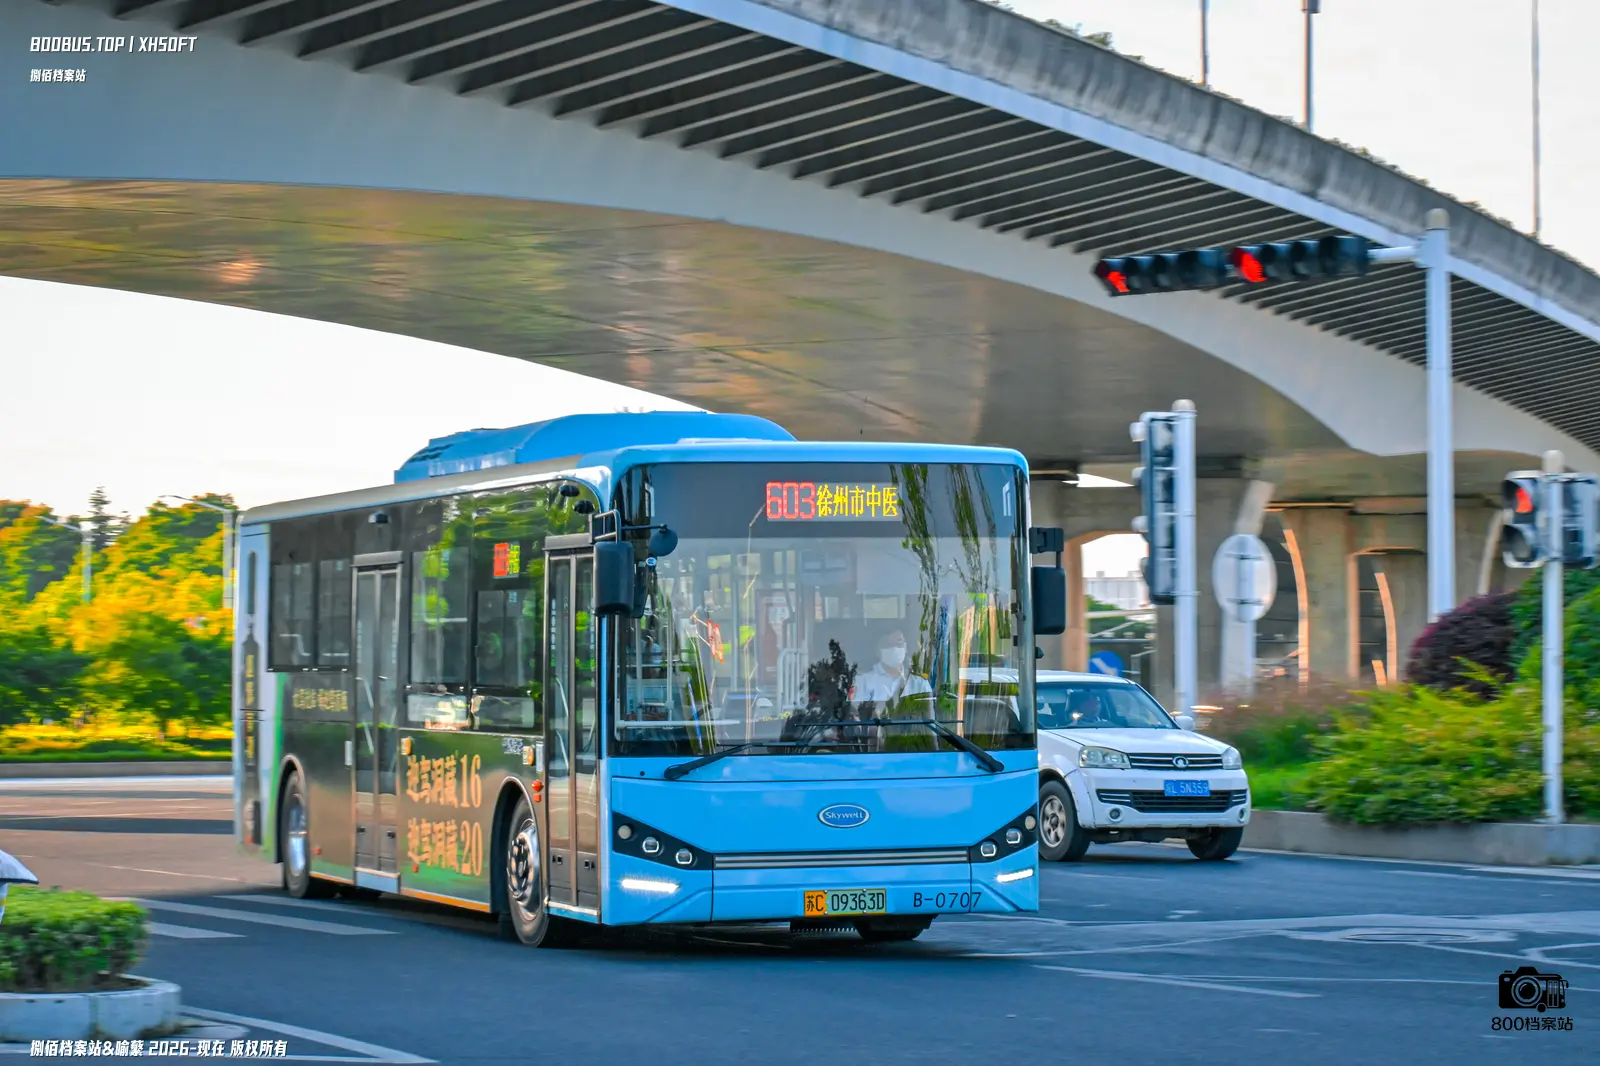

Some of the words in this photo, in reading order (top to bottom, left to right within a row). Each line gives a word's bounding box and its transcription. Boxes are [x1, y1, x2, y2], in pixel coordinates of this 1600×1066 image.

[766, 481, 816, 519] 603
[816, 484, 899, 517] 徐州市中医
[806, 894, 824, 912] 苏C
[831, 892, 885, 912] 09363D
[913, 892, 982, 909] B-0707
